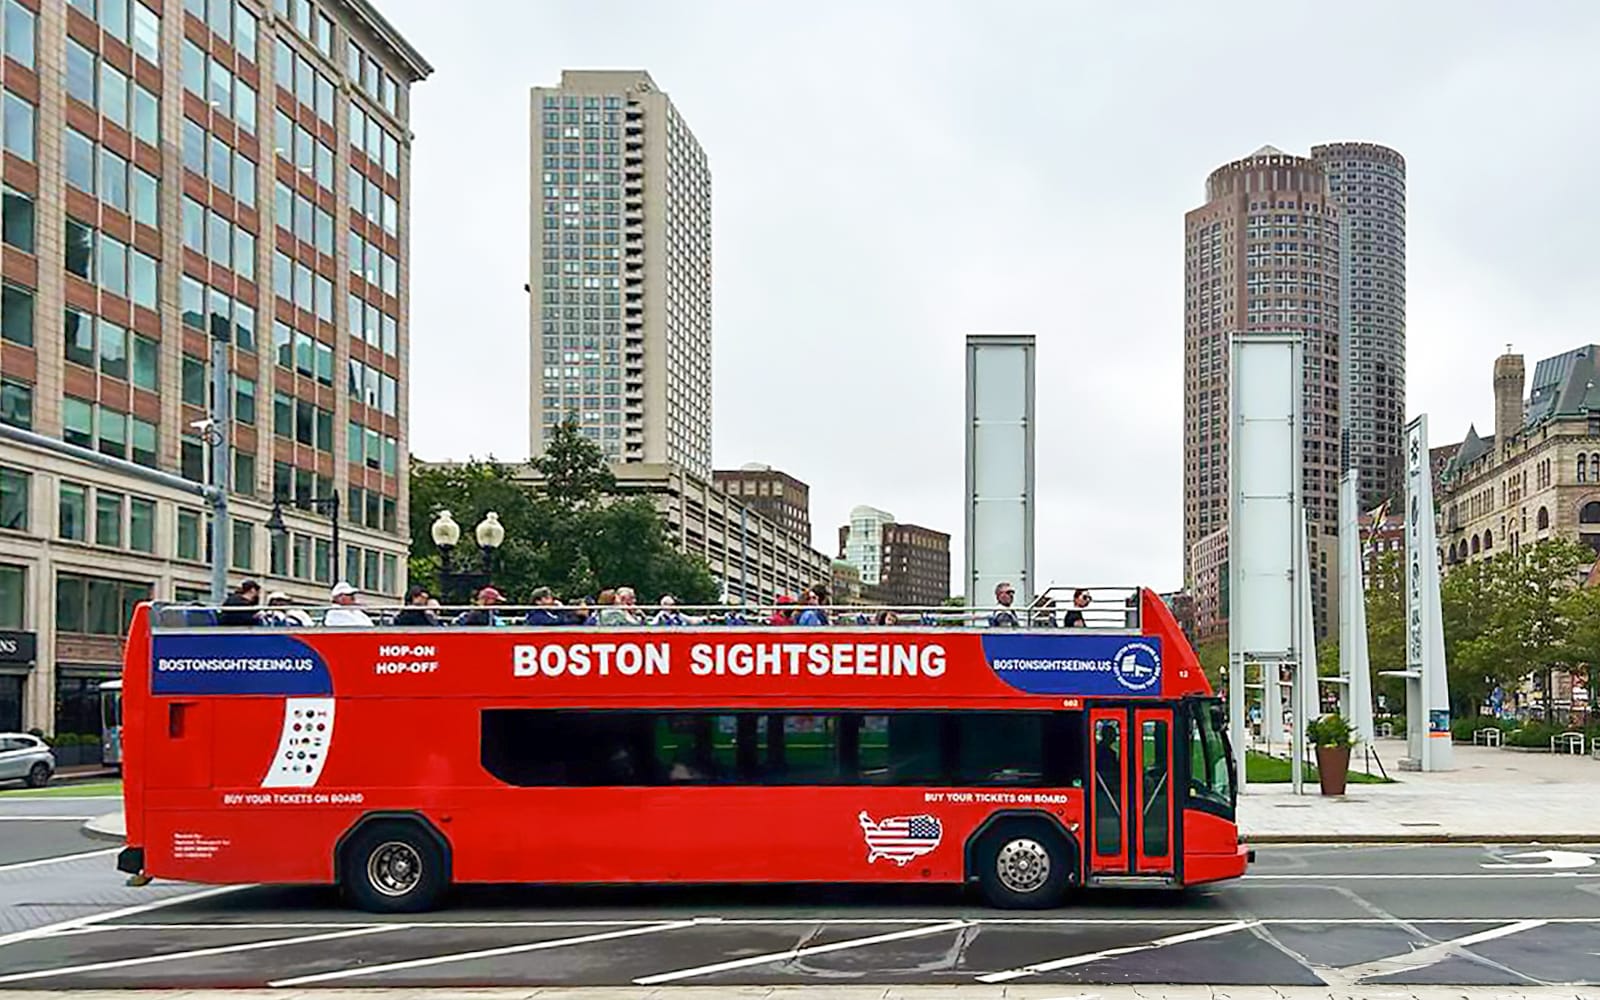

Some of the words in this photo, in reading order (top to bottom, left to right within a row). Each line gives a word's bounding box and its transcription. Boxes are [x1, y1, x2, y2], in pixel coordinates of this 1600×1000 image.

[379, 645, 436, 657] HOP-ON
[158, 658, 313, 672] BOSTONSIGHTSEEING.US
[513, 643, 670, 676] BOSTON
[690, 643, 946, 676] SIGHTSEEING
[993, 659, 1112, 672] BOSTONSIGHTSEEING.US
[376, 662, 439, 675] HOP-OFF
[223, 794, 244, 805] BUY
[245, 794, 272, 804] YOUR
[273, 794, 313, 804] TICKETS
[314, 794, 330, 804] ON
[330, 793, 364, 804] BOARD
[924, 793, 944, 802] BUY
[946, 793, 974, 803] YOUR
[975, 793, 1017, 803] TICKETS
[1017, 794, 1033, 803] ON
[1033, 794, 1068, 804] BOARD
